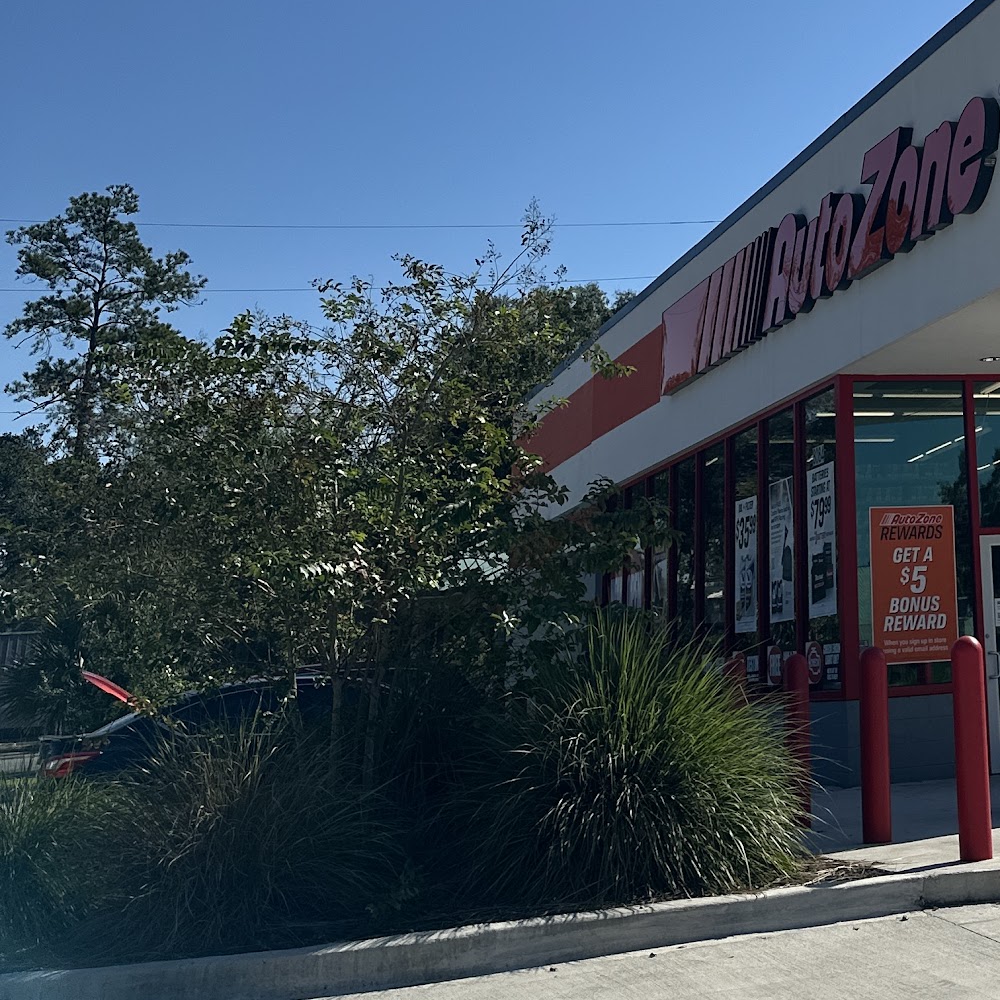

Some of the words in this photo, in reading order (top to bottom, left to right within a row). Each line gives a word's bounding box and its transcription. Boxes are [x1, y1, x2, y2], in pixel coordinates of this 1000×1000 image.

[762, 96, 1000, 333] AutoZone
[890, 512, 943, 525] AutoZone
[880, 525, 943, 540] REWARDS
[893, 547, 921, 563] GET
[923, 547, 933, 562] A
[900, 566, 928, 594] $5
[889, 595, 940, 613] BONUS
[883, 613, 947, 632] REWARD
[909, 638, 920, 646] sign
